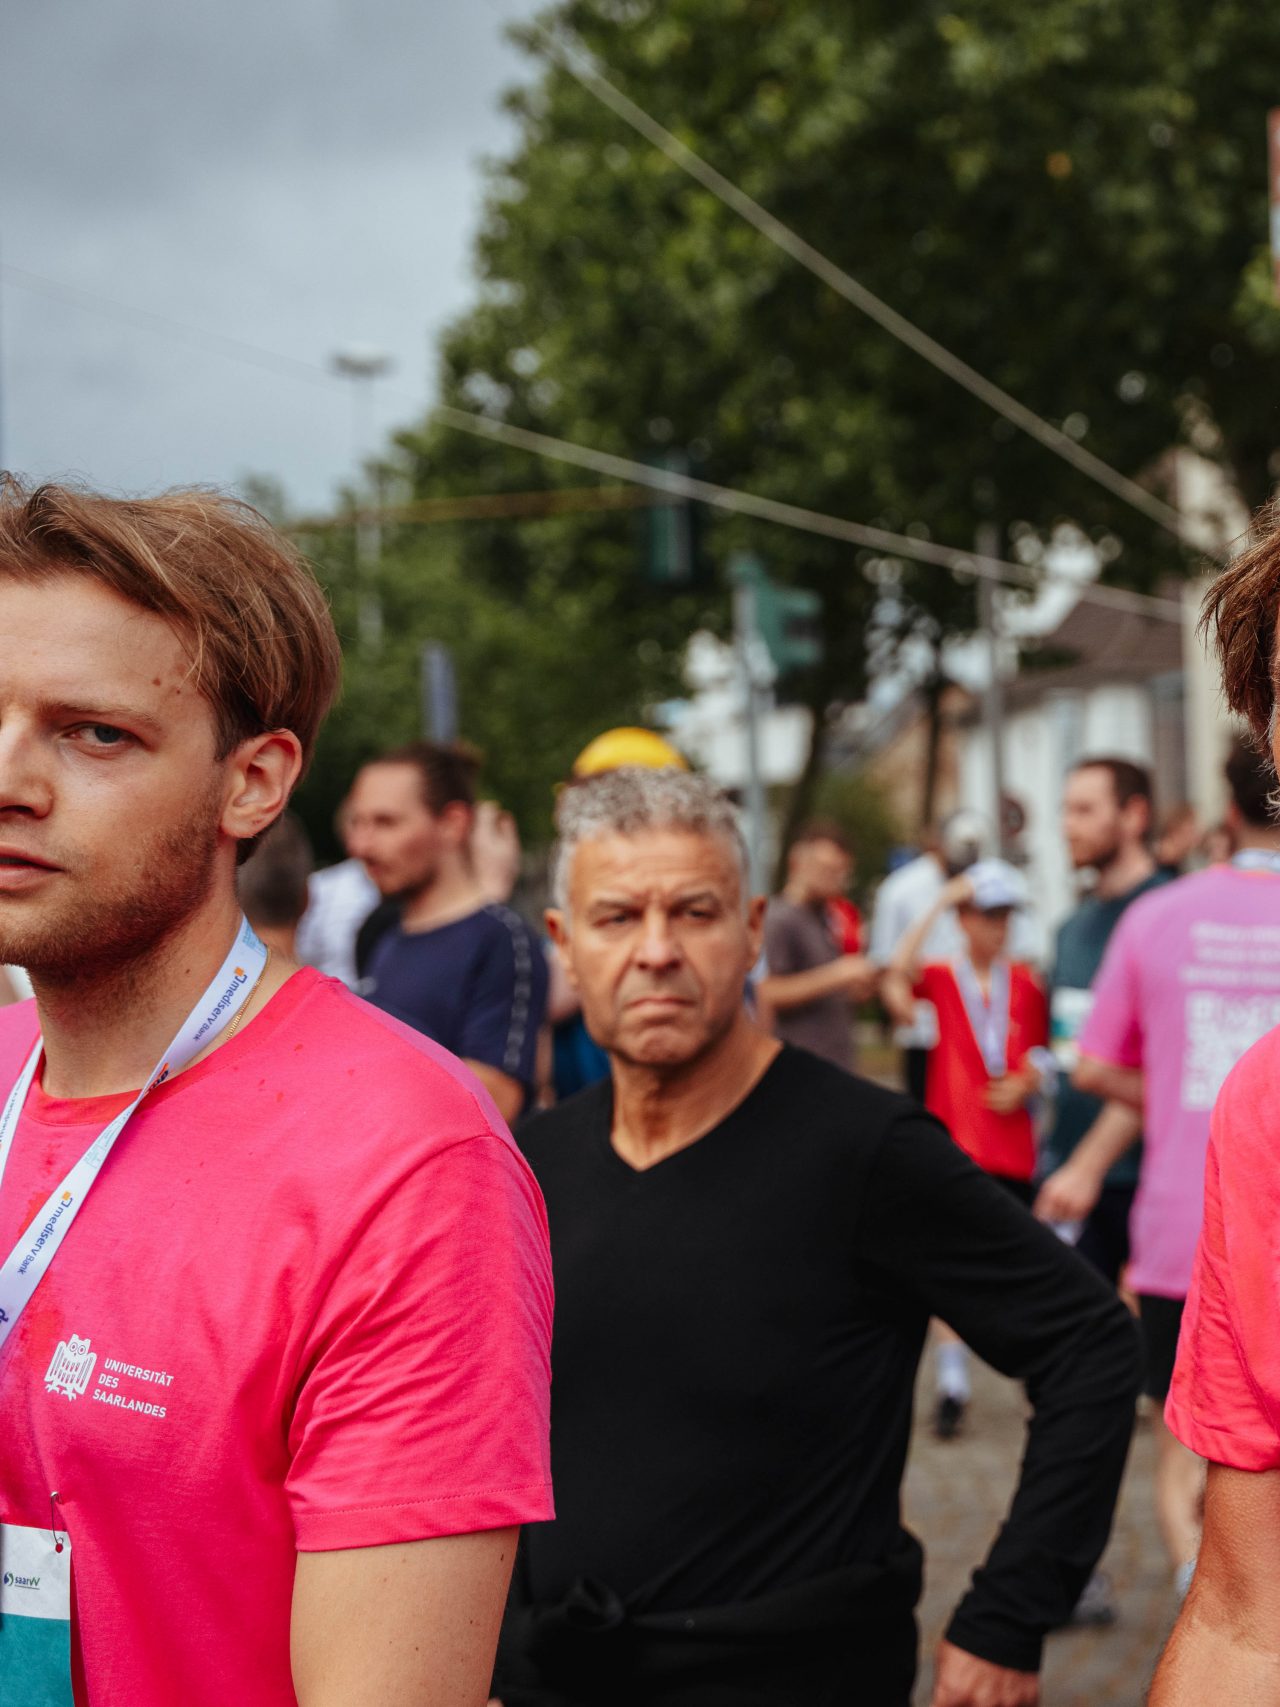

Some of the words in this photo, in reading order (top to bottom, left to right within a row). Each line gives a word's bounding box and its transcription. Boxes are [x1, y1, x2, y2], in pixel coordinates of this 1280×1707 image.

[208, 979, 241, 1026] mediserv
[31, 1206, 64, 1257] mediserv
[17, 1253, 35, 1275] Bank
[98, 1374, 119, 1389] DES
[104, 1358, 174, 1387] UNIVERSITÄT
[93, 1389, 167, 1418] SAARLANDES
